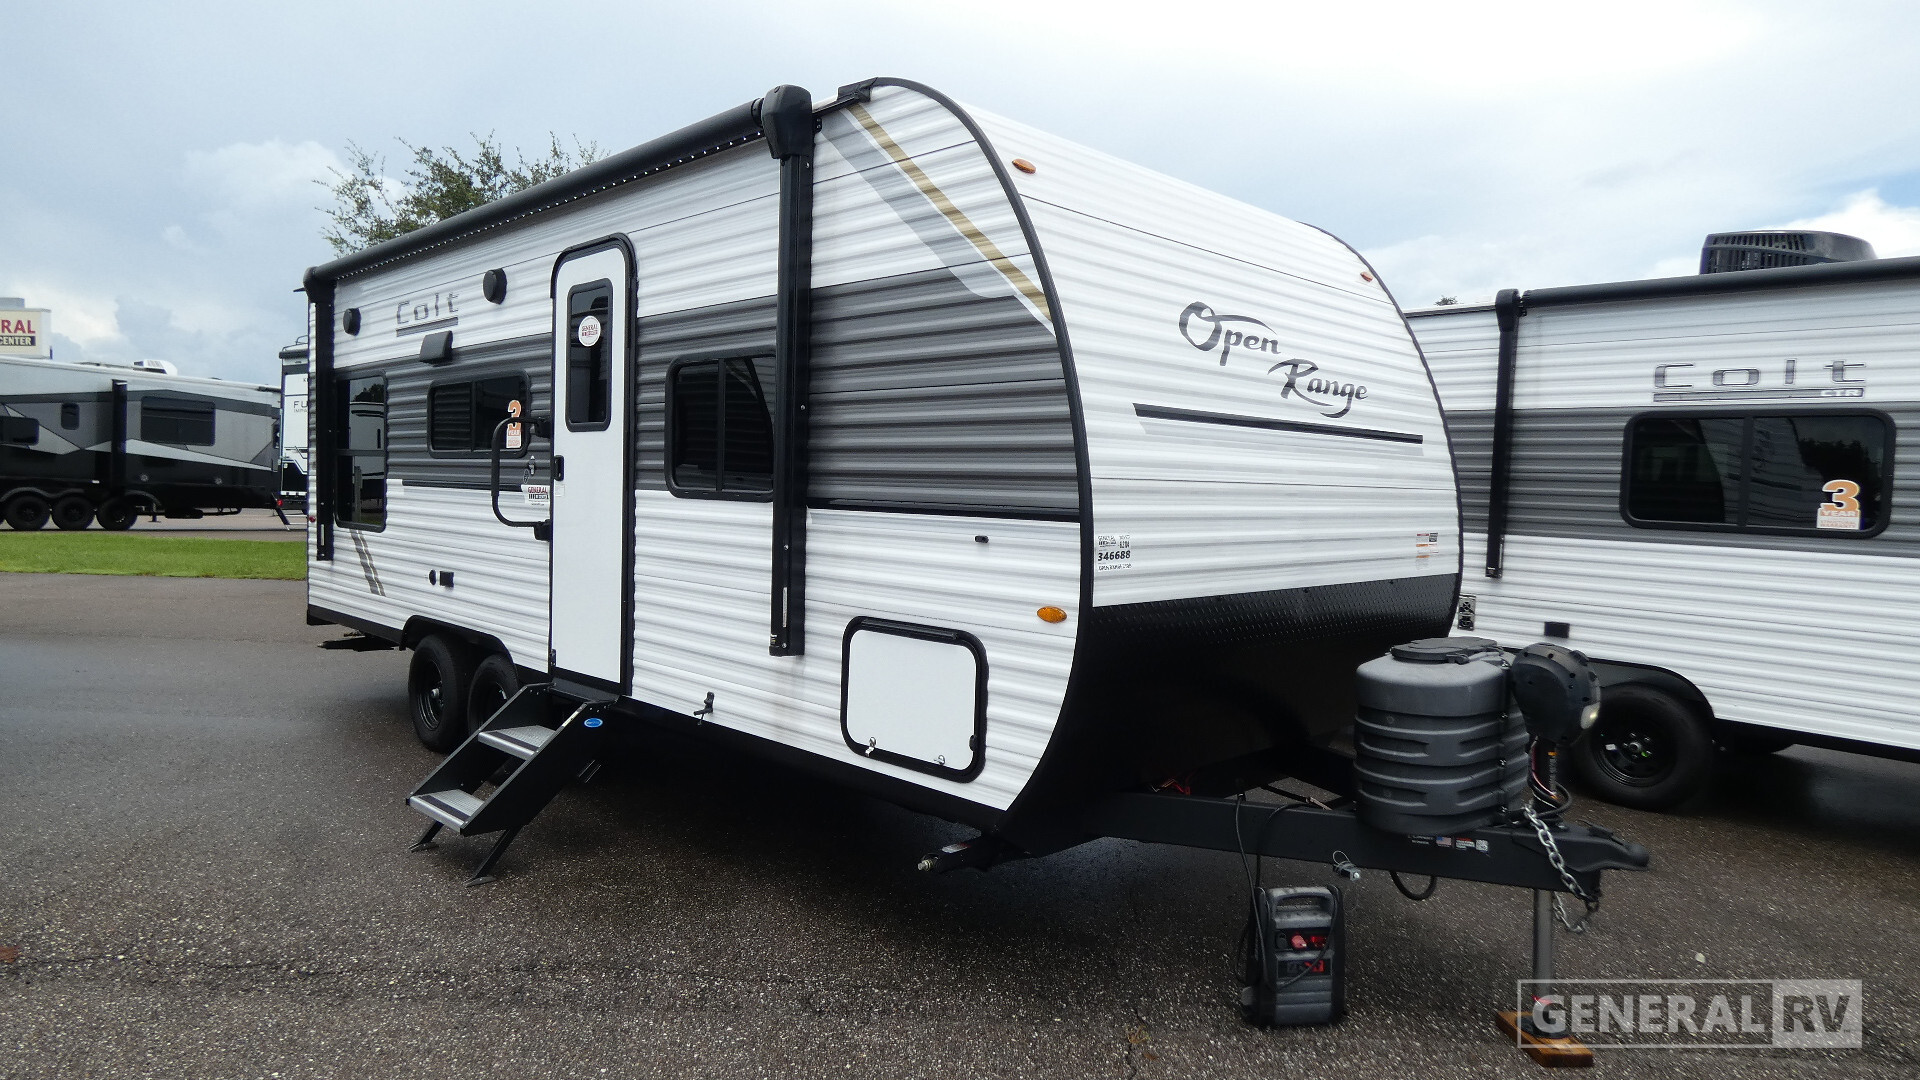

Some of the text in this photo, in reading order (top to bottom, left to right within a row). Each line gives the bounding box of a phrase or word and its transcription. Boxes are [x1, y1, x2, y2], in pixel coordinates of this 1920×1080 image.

[397, 292, 459, 324] Colt
[1178, 301, 1281, 366] Open
[1267, 358, 1368, 419] Range
[1654, 359, 1866, 388] Colt
[1820, 388, 1861, 397] CTR
[1820, 479, 1859, 511] 3
[1097, 550, 1131, 562] 346688
